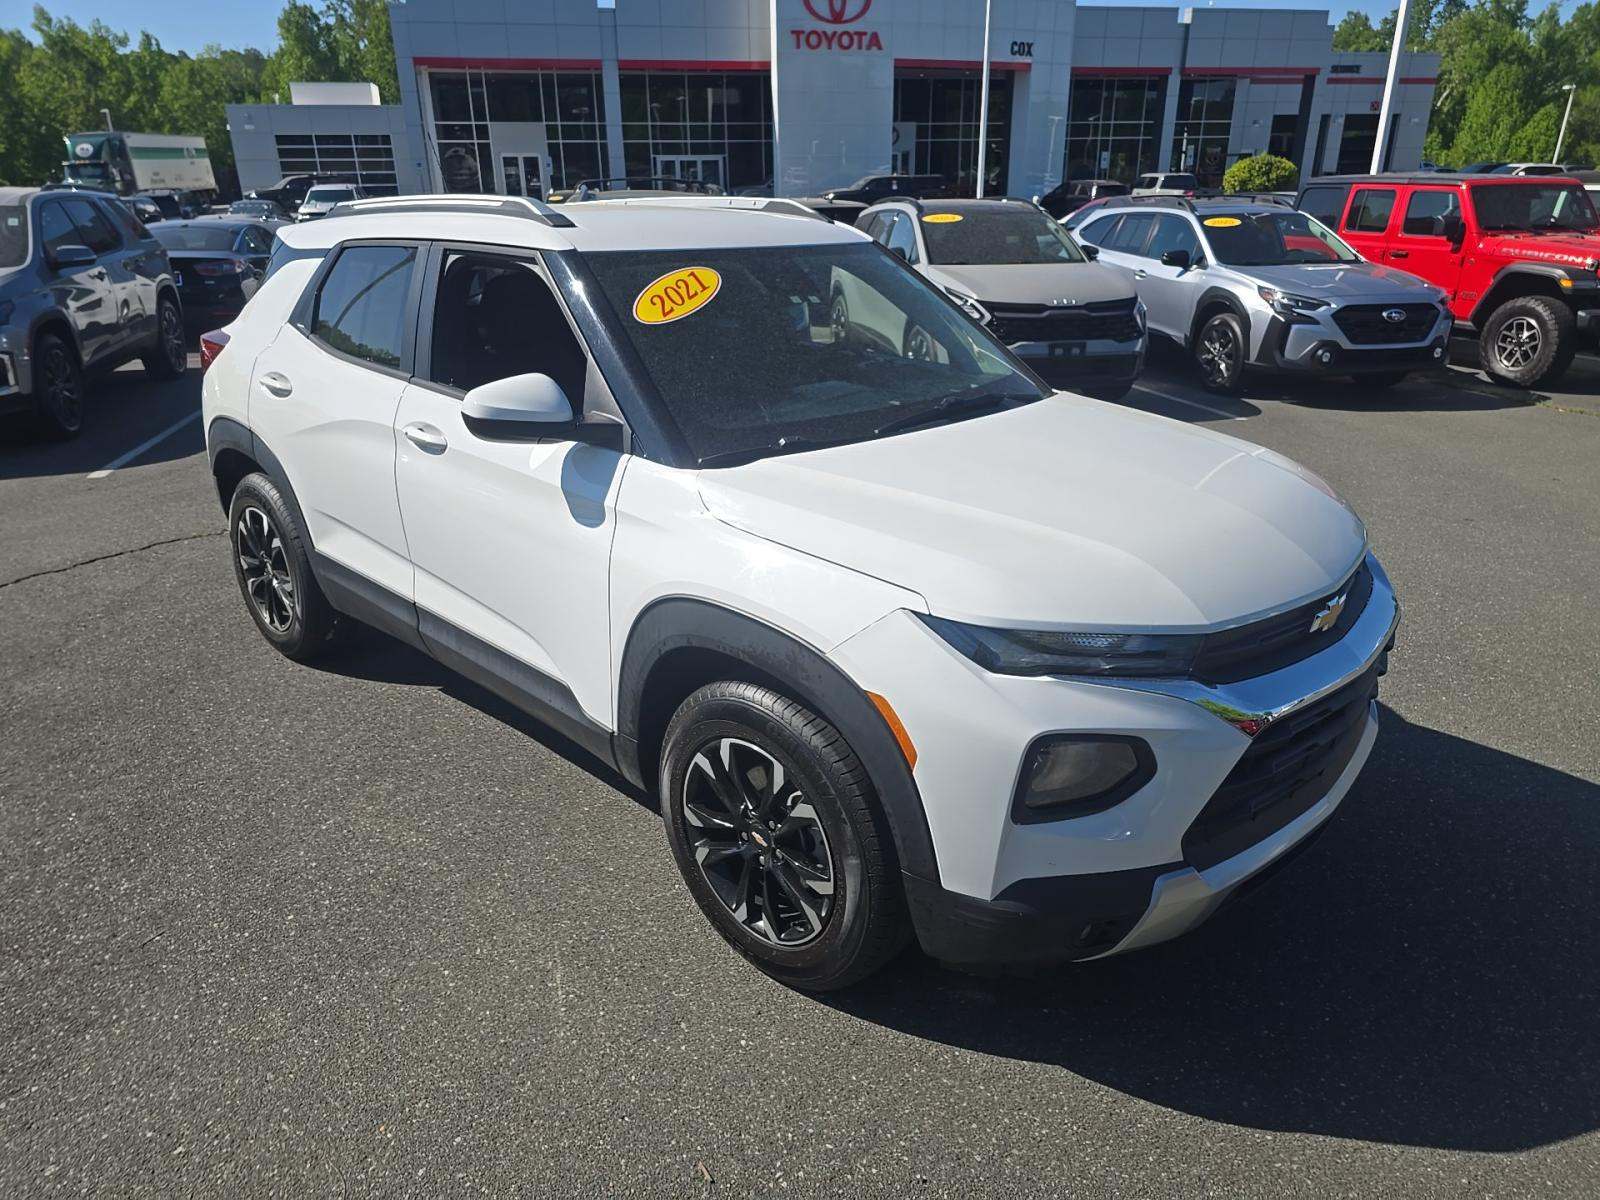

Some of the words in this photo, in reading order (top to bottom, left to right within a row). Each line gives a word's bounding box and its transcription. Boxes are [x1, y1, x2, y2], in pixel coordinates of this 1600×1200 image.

[790, 29, 883, 50] TOYOTA
[1010, 40, 1034, 57] COX
[1502, 247, 1584, 263] RUBICON
[650, 271, 710, 318] 2021
